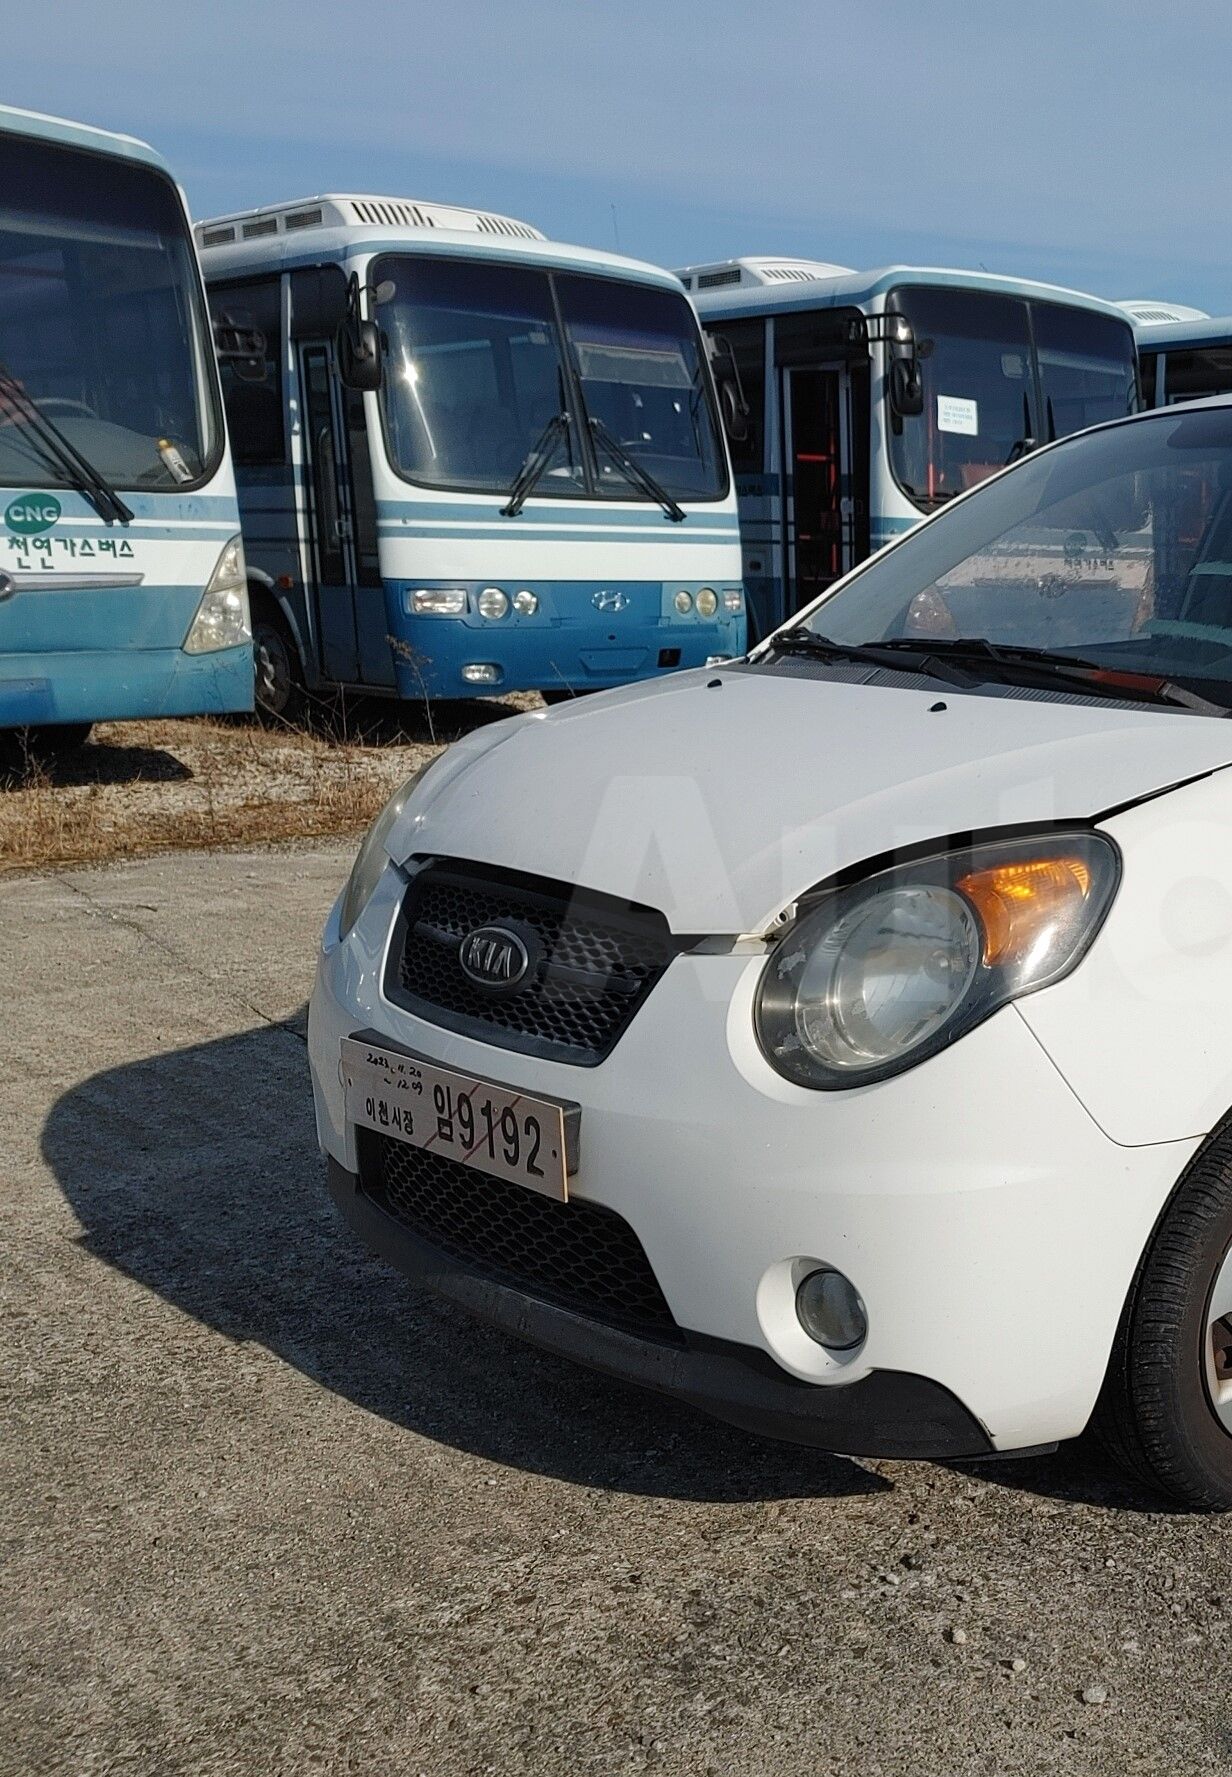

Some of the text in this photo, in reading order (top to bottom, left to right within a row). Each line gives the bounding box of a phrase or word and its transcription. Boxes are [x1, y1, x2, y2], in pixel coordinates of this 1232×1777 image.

[9, 505, 59, 521] CNG
[8, 537, 134, 570] 천연가스버스
[467, 937, 512, 978] KIA
[366, 1097, 414, 1135] 이천시장
